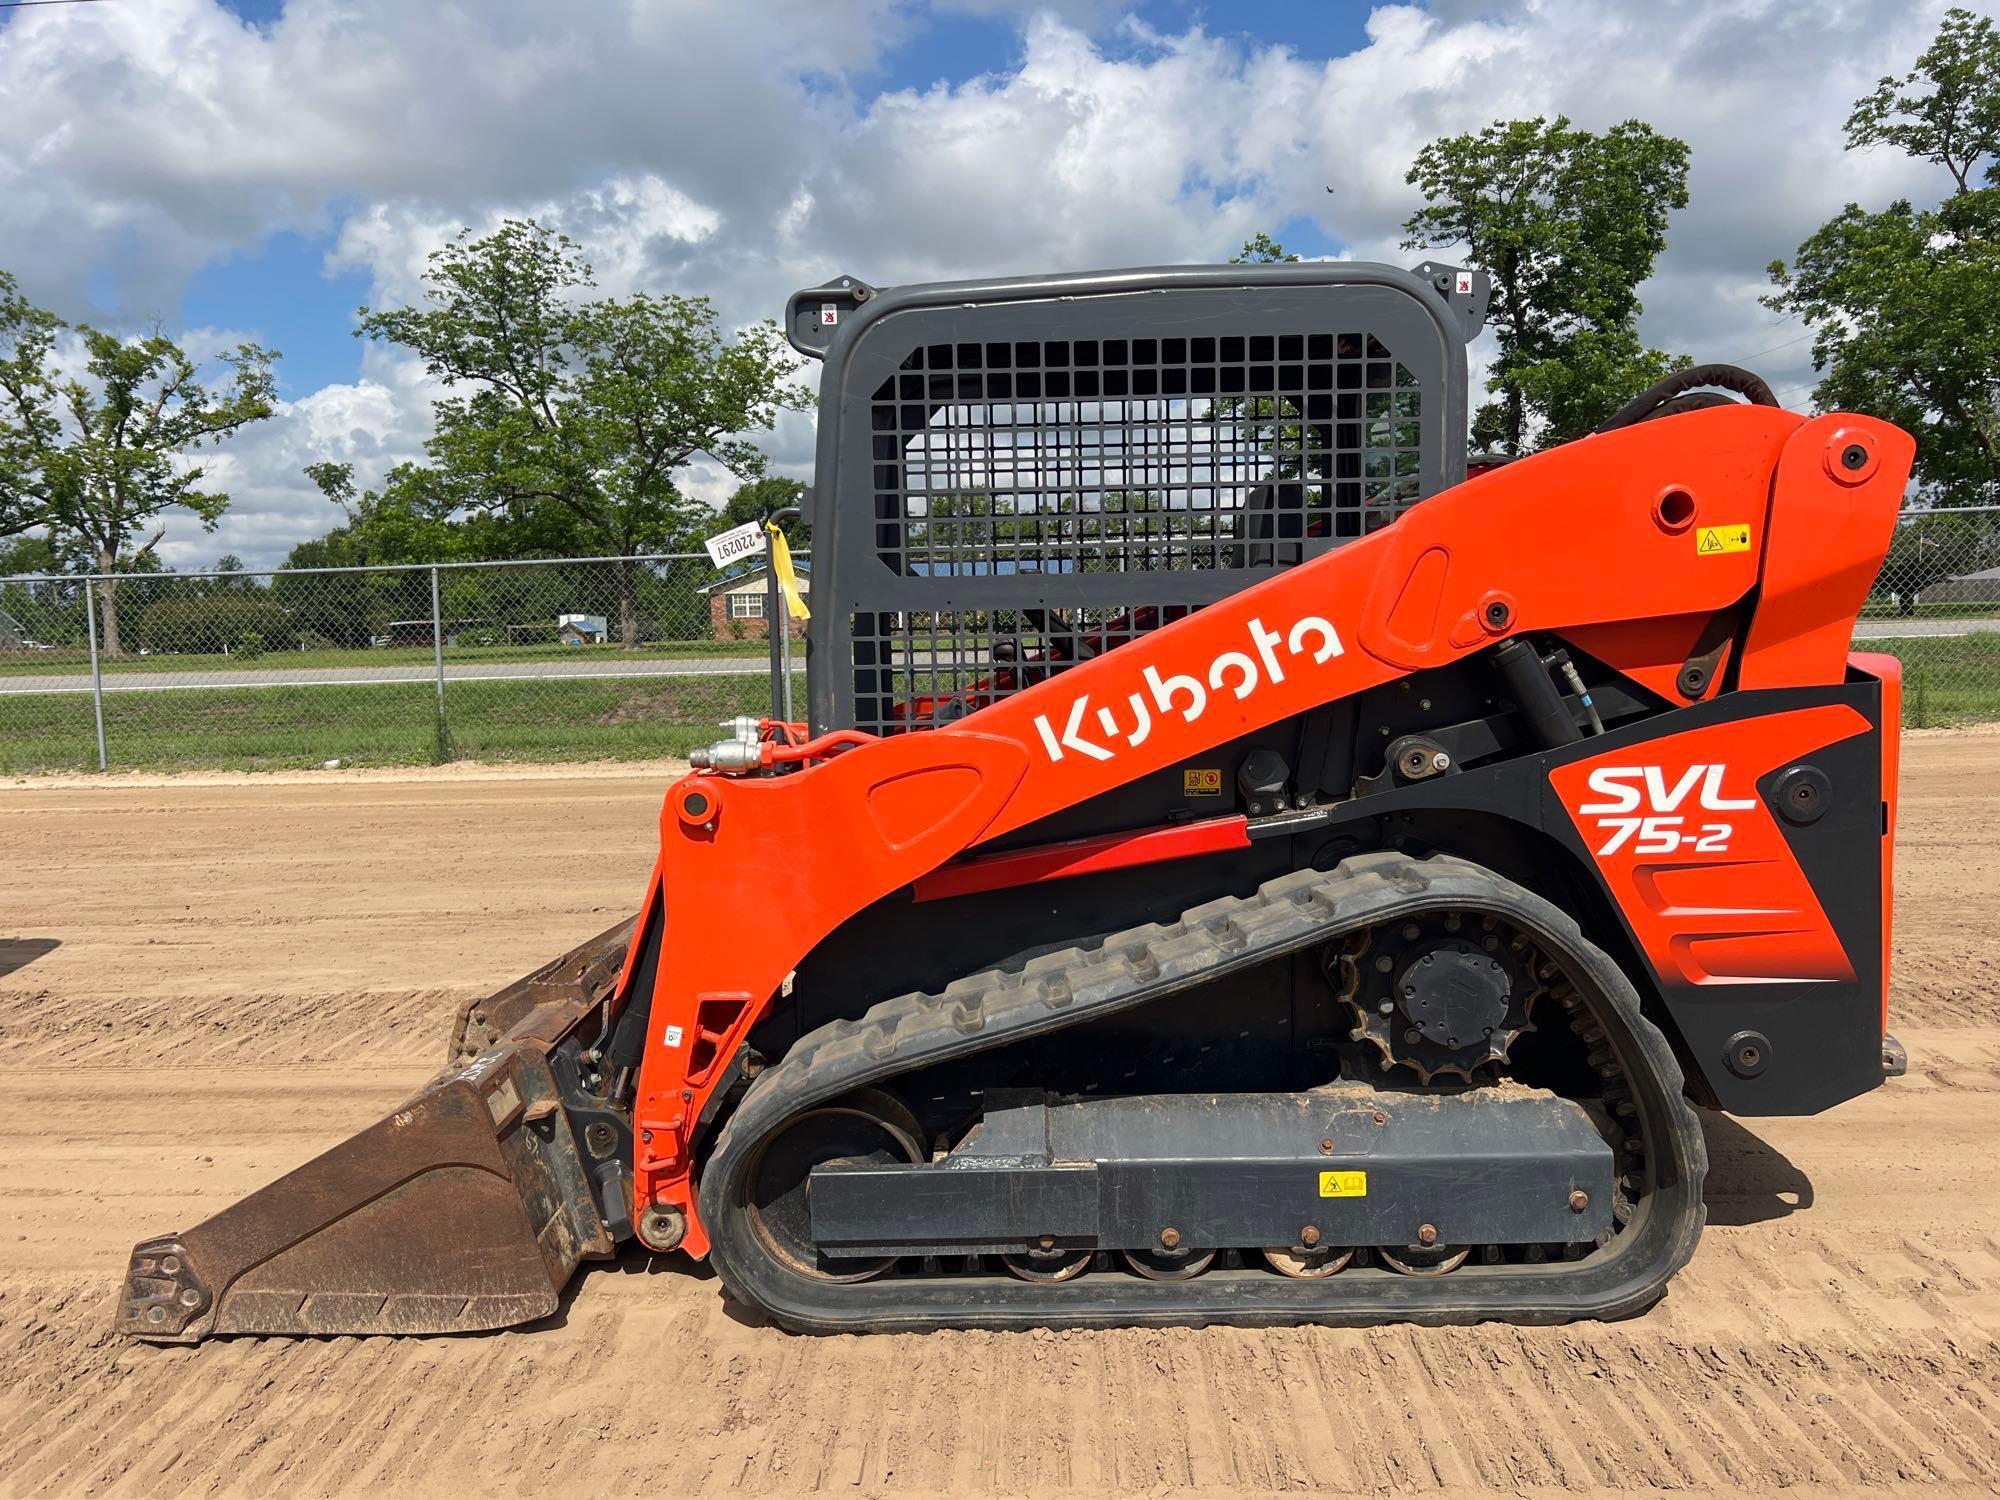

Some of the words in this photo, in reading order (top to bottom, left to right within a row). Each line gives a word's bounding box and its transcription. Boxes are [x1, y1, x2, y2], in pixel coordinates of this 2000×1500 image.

[718, 535, 756, 560] 220297
[1034, 617, 1344, 762] Kubota
[1579, 764, 1757, 814] SVL
[1596, 816, 1733, 856] 75-2
